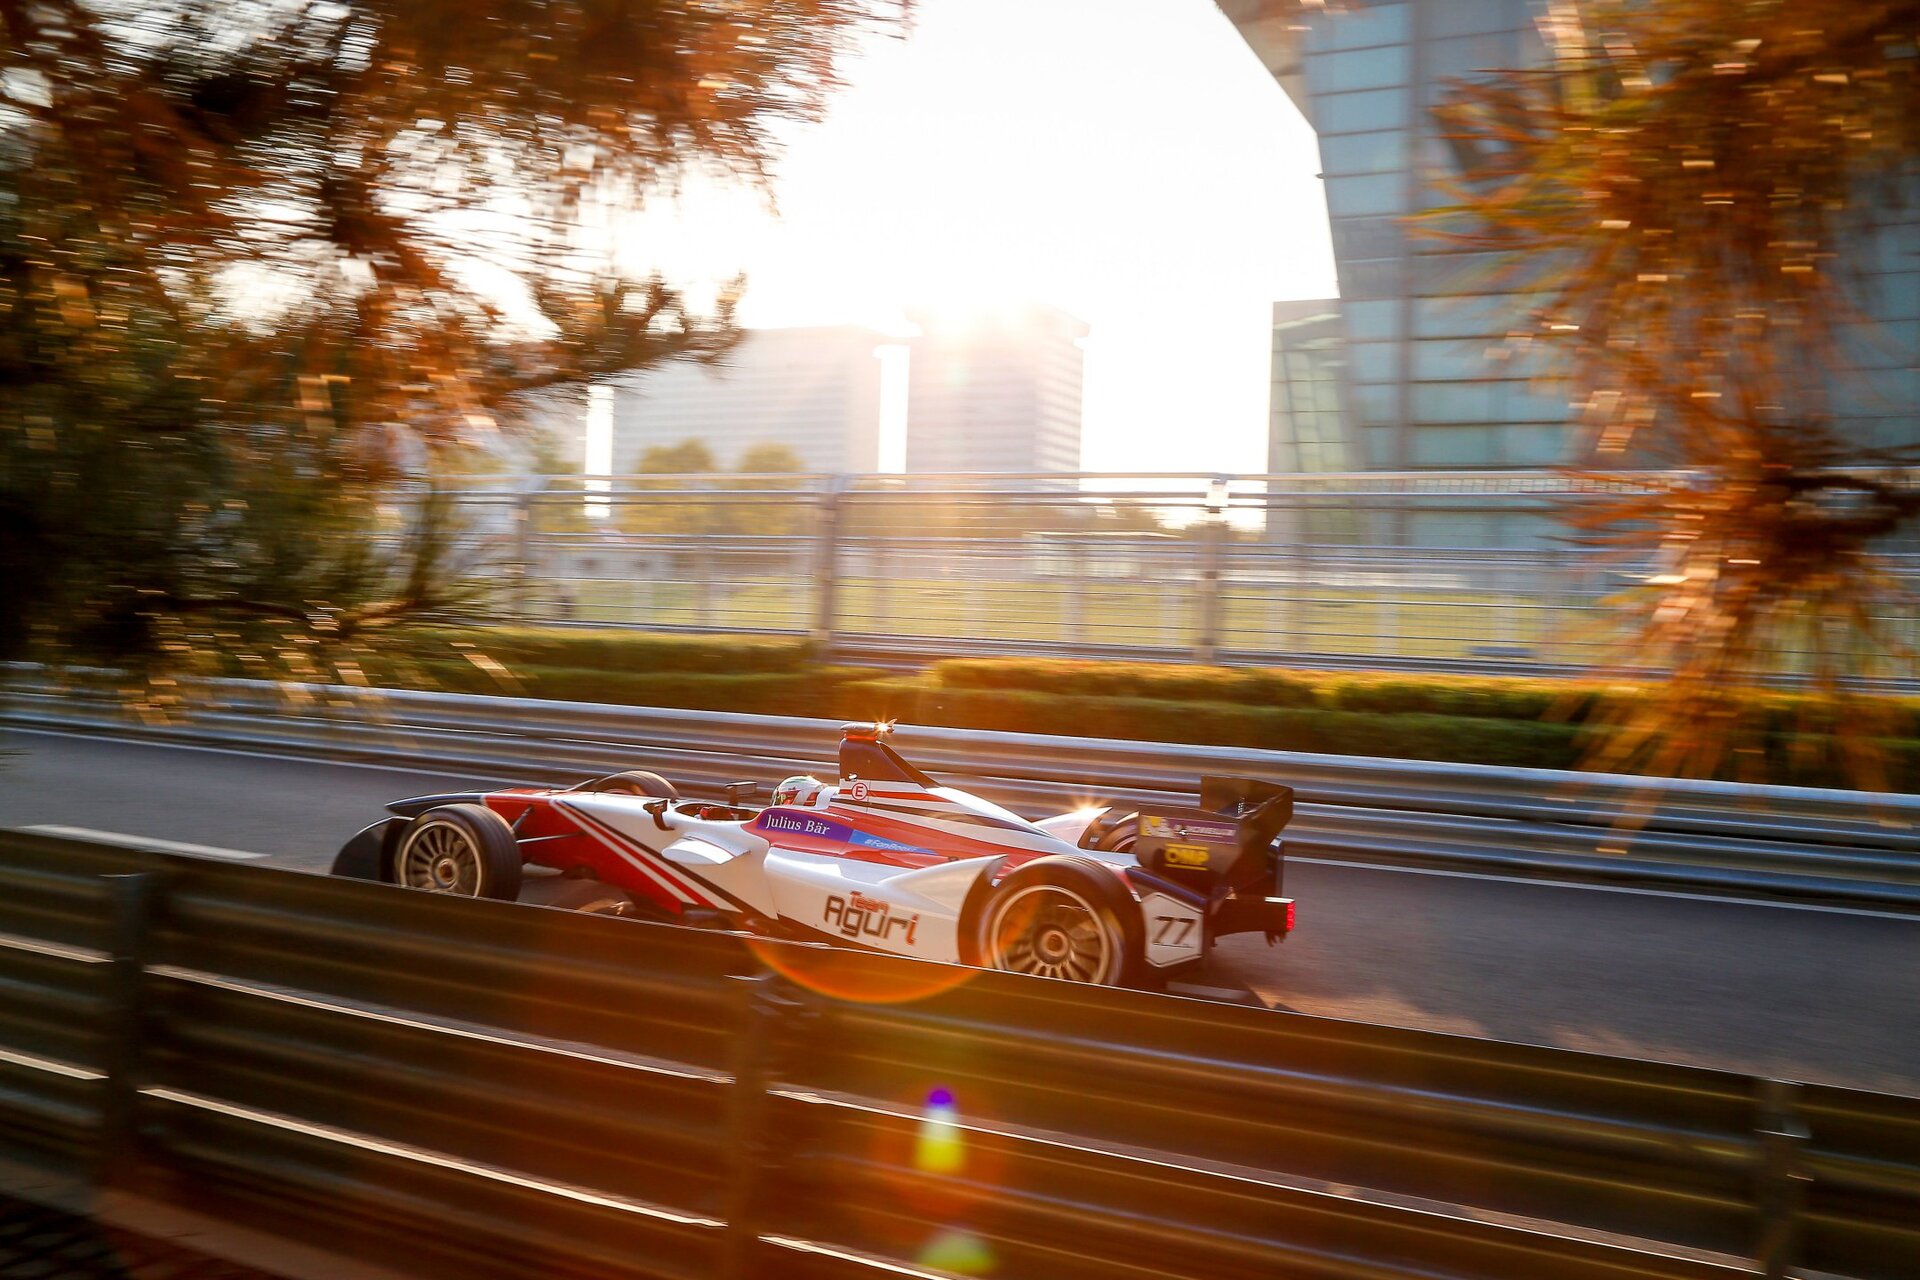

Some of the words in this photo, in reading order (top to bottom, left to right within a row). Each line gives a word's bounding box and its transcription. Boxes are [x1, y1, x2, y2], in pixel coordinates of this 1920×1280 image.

[855, 786, 864, 797] E
[766, 814, 802, 831] Julius
[805, 820, 830, 835] Bär
[850, 890, 889, 915] Team
[824, 894, 919, 946] Aguri
[1152, 915, 1196, 945] 77
